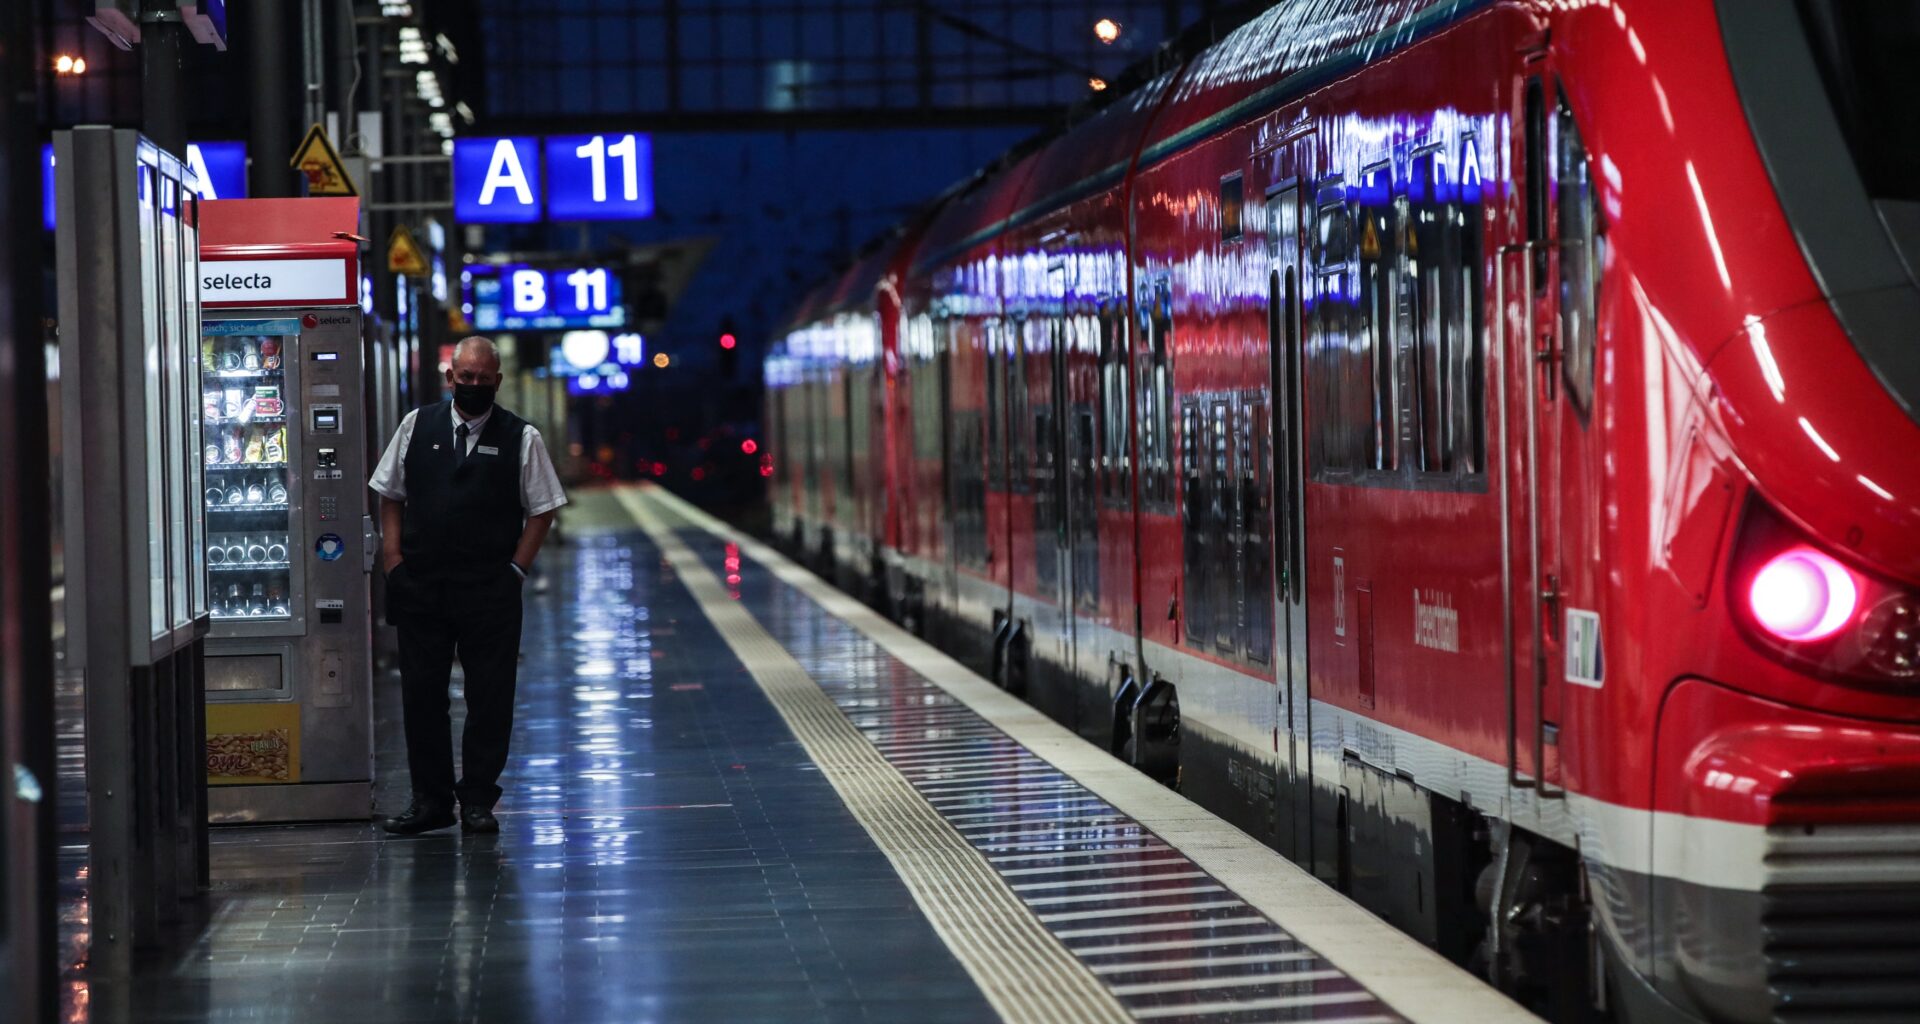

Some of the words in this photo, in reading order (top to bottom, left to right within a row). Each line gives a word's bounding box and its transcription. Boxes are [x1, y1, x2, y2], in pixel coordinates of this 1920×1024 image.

[187, 144, 217, 200] A
[478, 139, 533, 205] A
[576, 135, 638, 203] 11
[202, 273, 272, 290] selecta
[513, 269, 546, 312] B
[567, 268, 607, 311] 11
[202, 324, 228, 333] nisch,
[319, 316, 351, 325] selecta
[207, 753, 247, 768] om
[250, 738, 280, 753] PEANUTS
